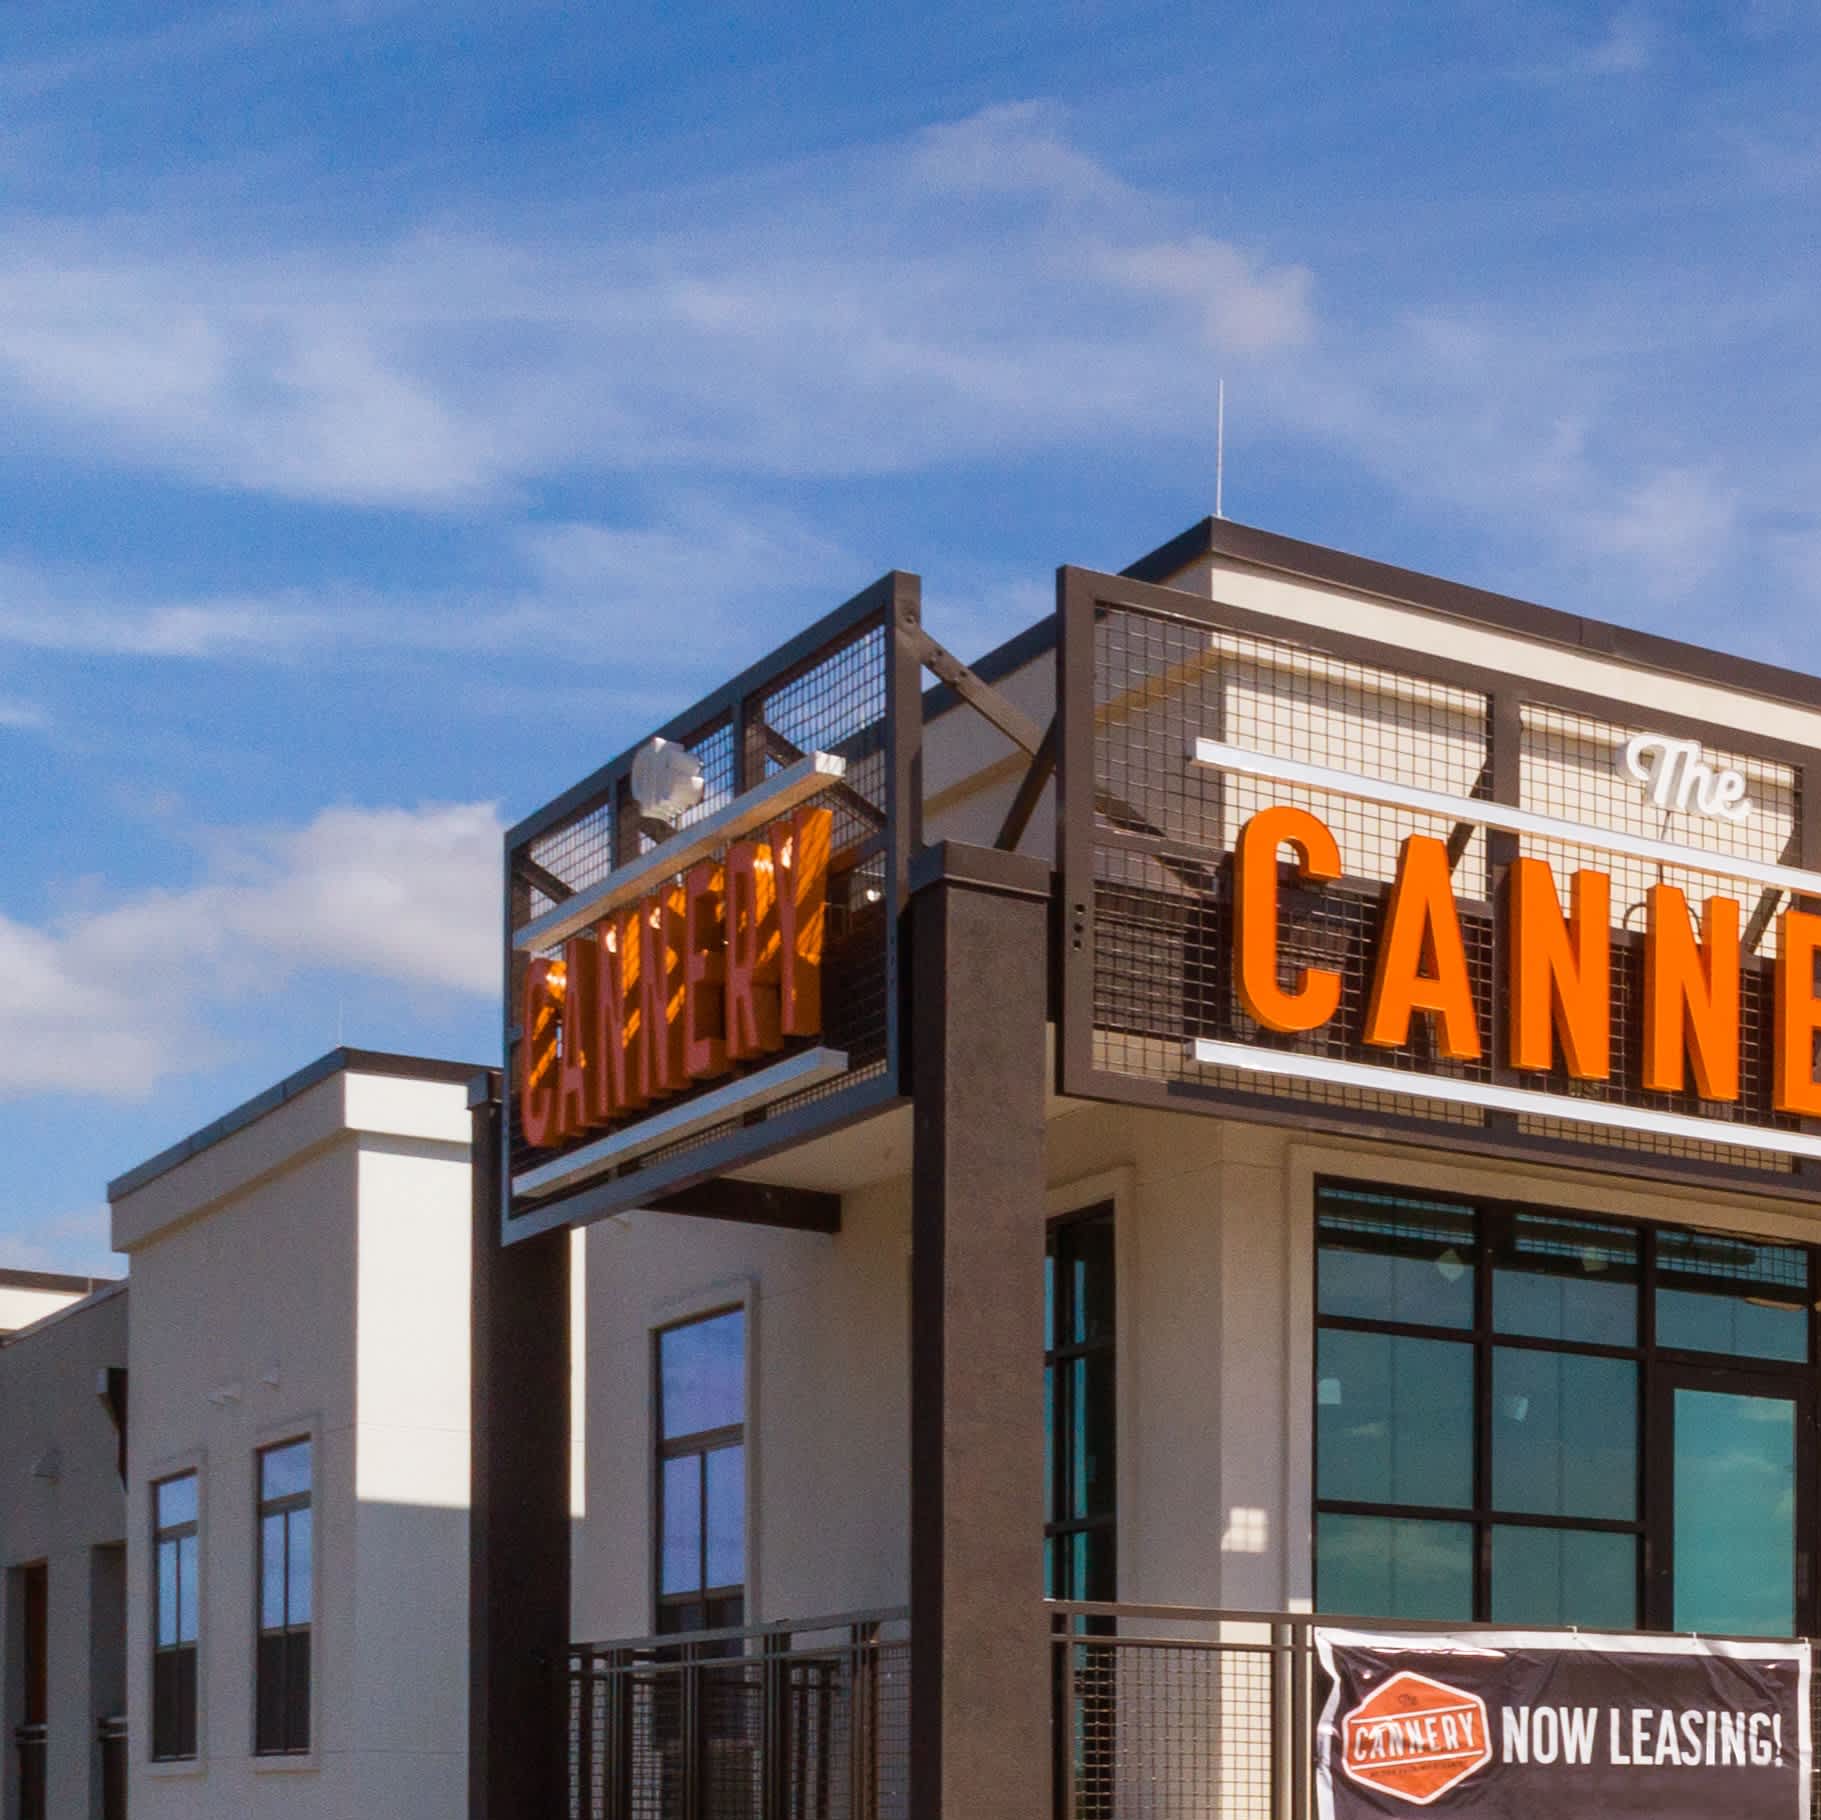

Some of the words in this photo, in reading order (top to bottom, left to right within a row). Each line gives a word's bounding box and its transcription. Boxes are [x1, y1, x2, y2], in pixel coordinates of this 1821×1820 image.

[1616, 732, 1753, 822] The
[521, 806, 833, 1148] CANNERY
[1353, 1711, 1475, 1761] CANNERY
[1502, 1705, 1598, 1765] NOW
[1610, 1707, 1784, 1768] LEASING!
